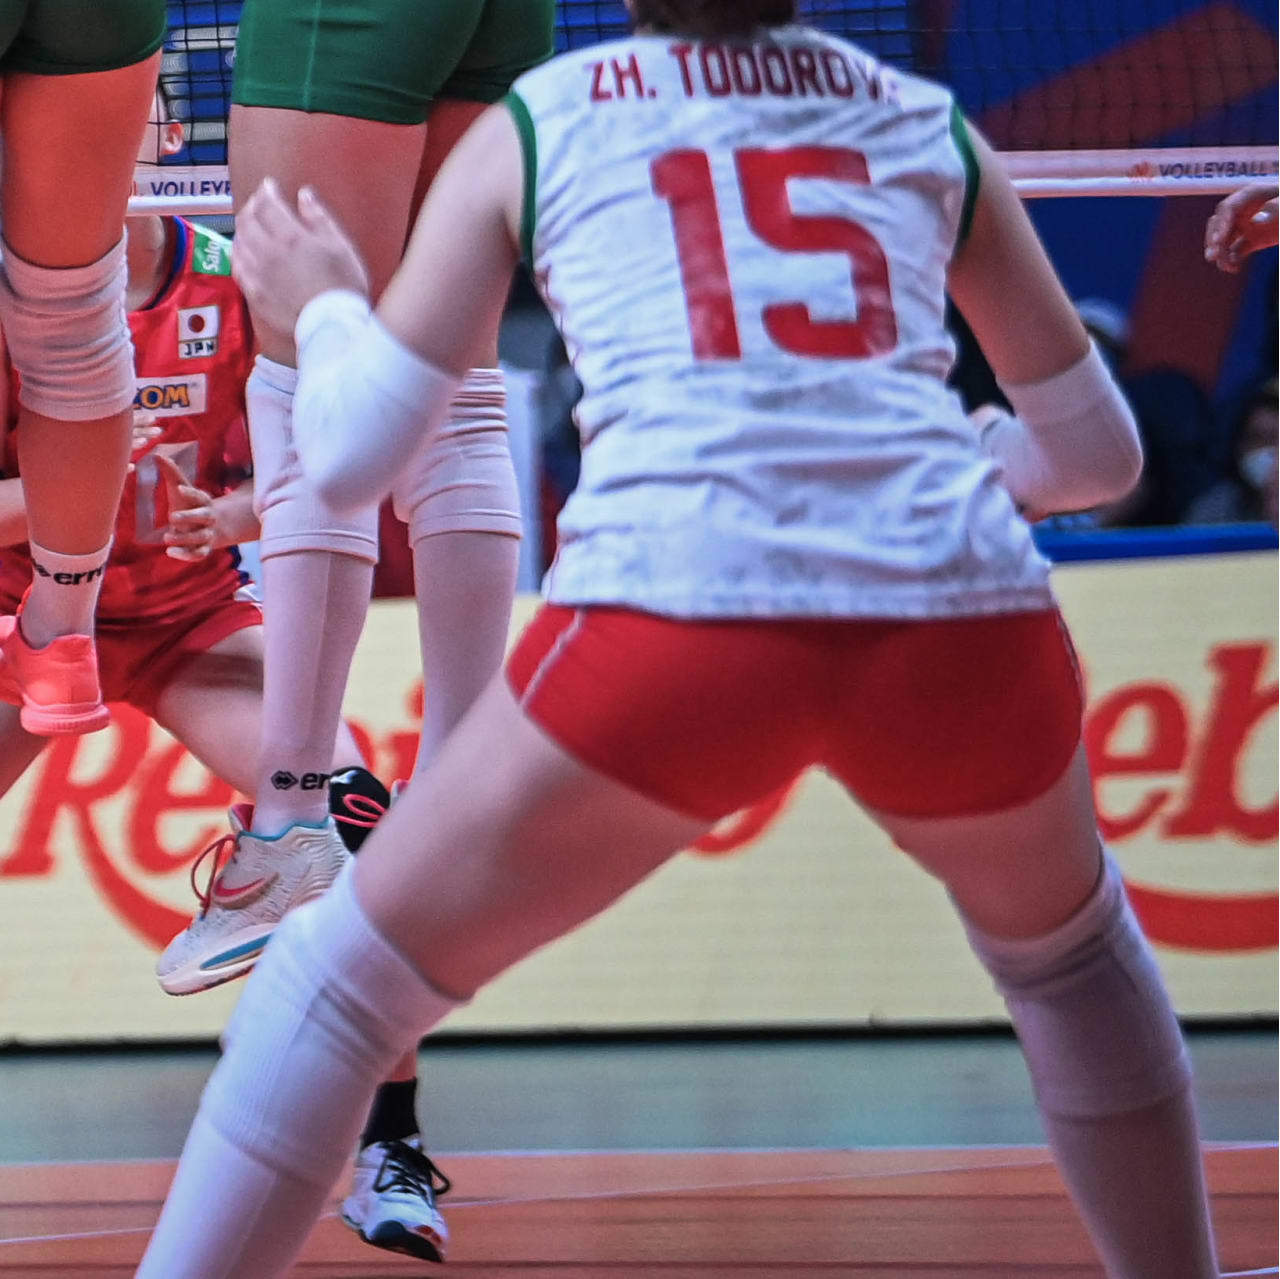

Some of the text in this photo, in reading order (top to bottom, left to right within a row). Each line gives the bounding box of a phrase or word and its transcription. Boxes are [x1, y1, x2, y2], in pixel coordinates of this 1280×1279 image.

[583, 52, 657, 103] ZH.
[650, 144, 898, 361] 15
[184, 341, 215, 356] JPN
